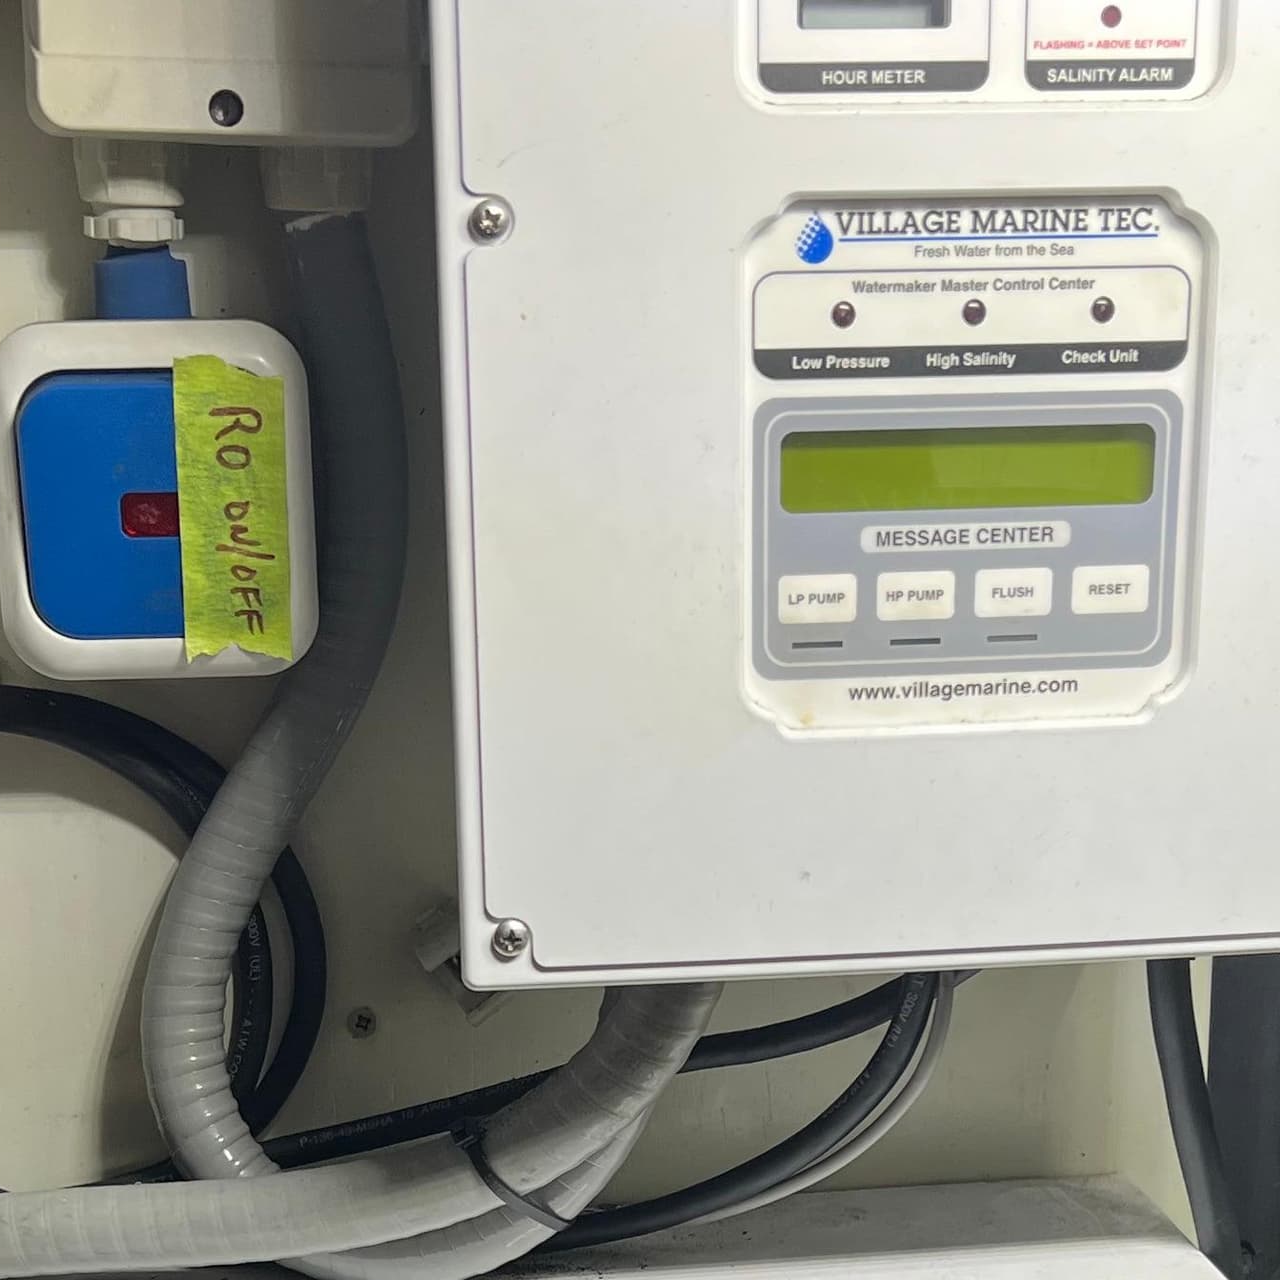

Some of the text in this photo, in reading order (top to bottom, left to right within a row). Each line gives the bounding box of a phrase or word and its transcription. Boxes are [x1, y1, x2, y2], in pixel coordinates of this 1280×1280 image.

[1034, 39, 1084, 50] FLASHING
[1096, 39, 1131, 49] ABOVE
[1134, 39, 1153, 48] SET
[1156, 38, 1187, 48] POINT
[822, 69, 926, 85] HOUR METER
[1047, 66, 1173, 83] SALINITY ALARM
[835, 206, 1160, 236] VILLAGE MARINE TEC.
[914, 243, 1075, 258] Fresh Water from the Sea
[851, 276, 1096, 295] Watermaker Master Control Center
[792, 354, 890, 370] Low Pressure
[926, 351, 1016, 368] High Salinity
[1062, 347, 1139, 364] Check Unit
[209, 406, 263, 471] RO
[876, 526, 1055, 548] MESSAGE CENTER
[885, 589, 944, 603] HP PUMP
[991, 586, 1034, 599] FLUSH
[1088, 583, 1131, 596] RESET
[788, 592, 846, 606] LP PUMP
[848, 677, 1079, 702] www.villagemarine.com
